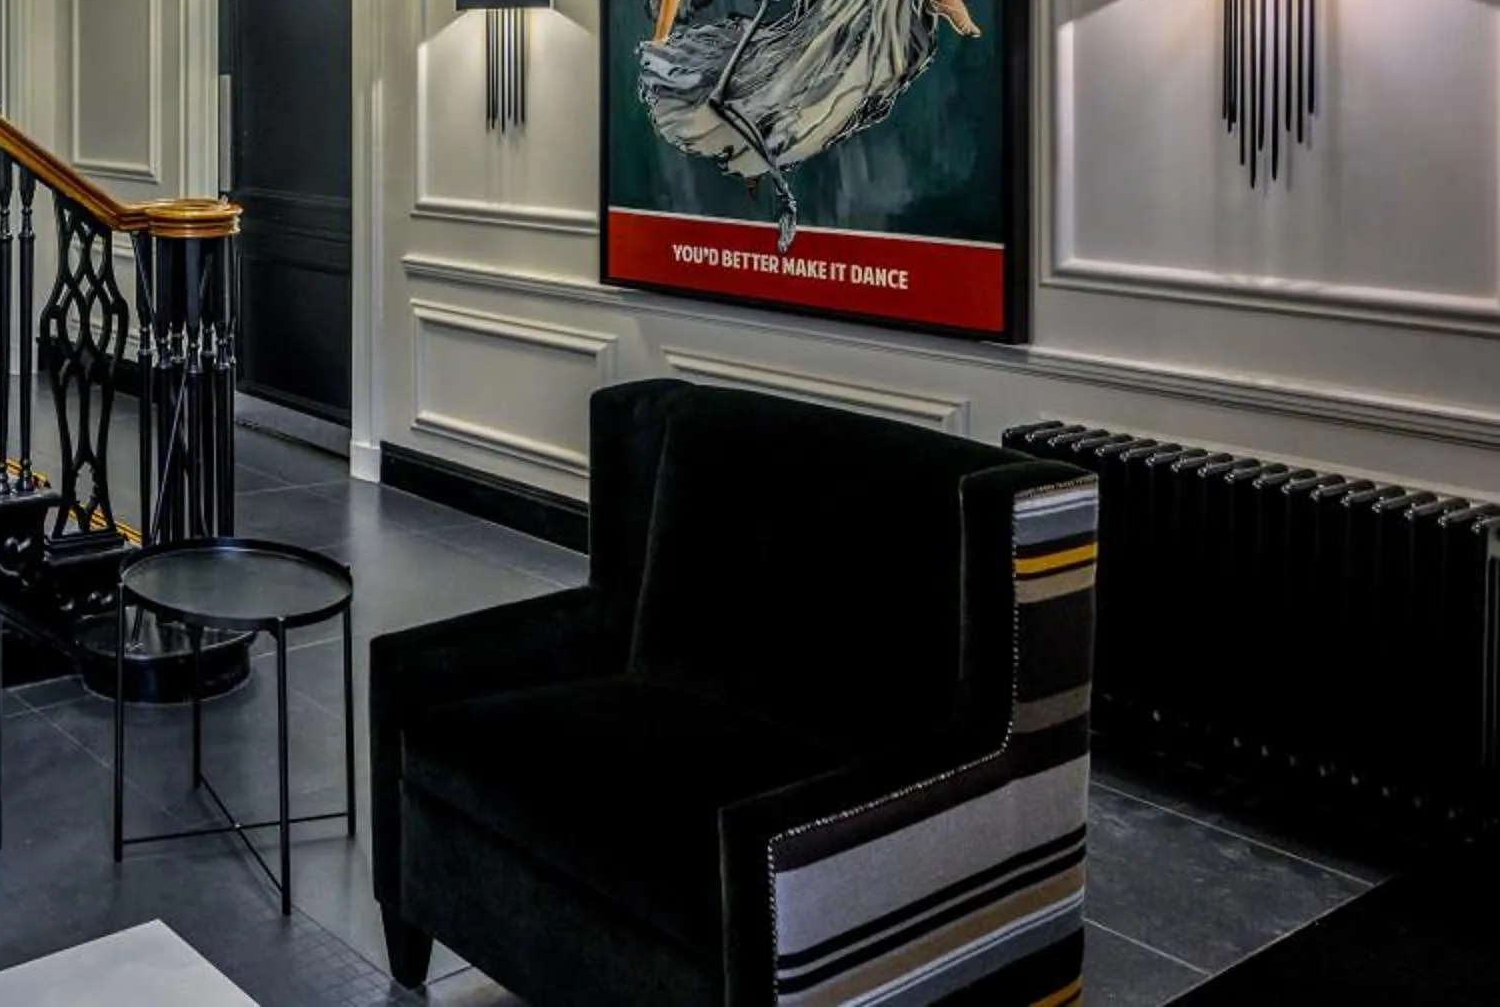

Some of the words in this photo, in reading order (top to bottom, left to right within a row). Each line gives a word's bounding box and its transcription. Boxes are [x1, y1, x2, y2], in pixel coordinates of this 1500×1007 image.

[672, 244, 718, 266] YOU'D
[721, 251, 779, 274] BETTER
[781, 257, 827, 280] MAKE
[829, 263, 847, 282] IT
[851, 264, 909, 290] DANCE
